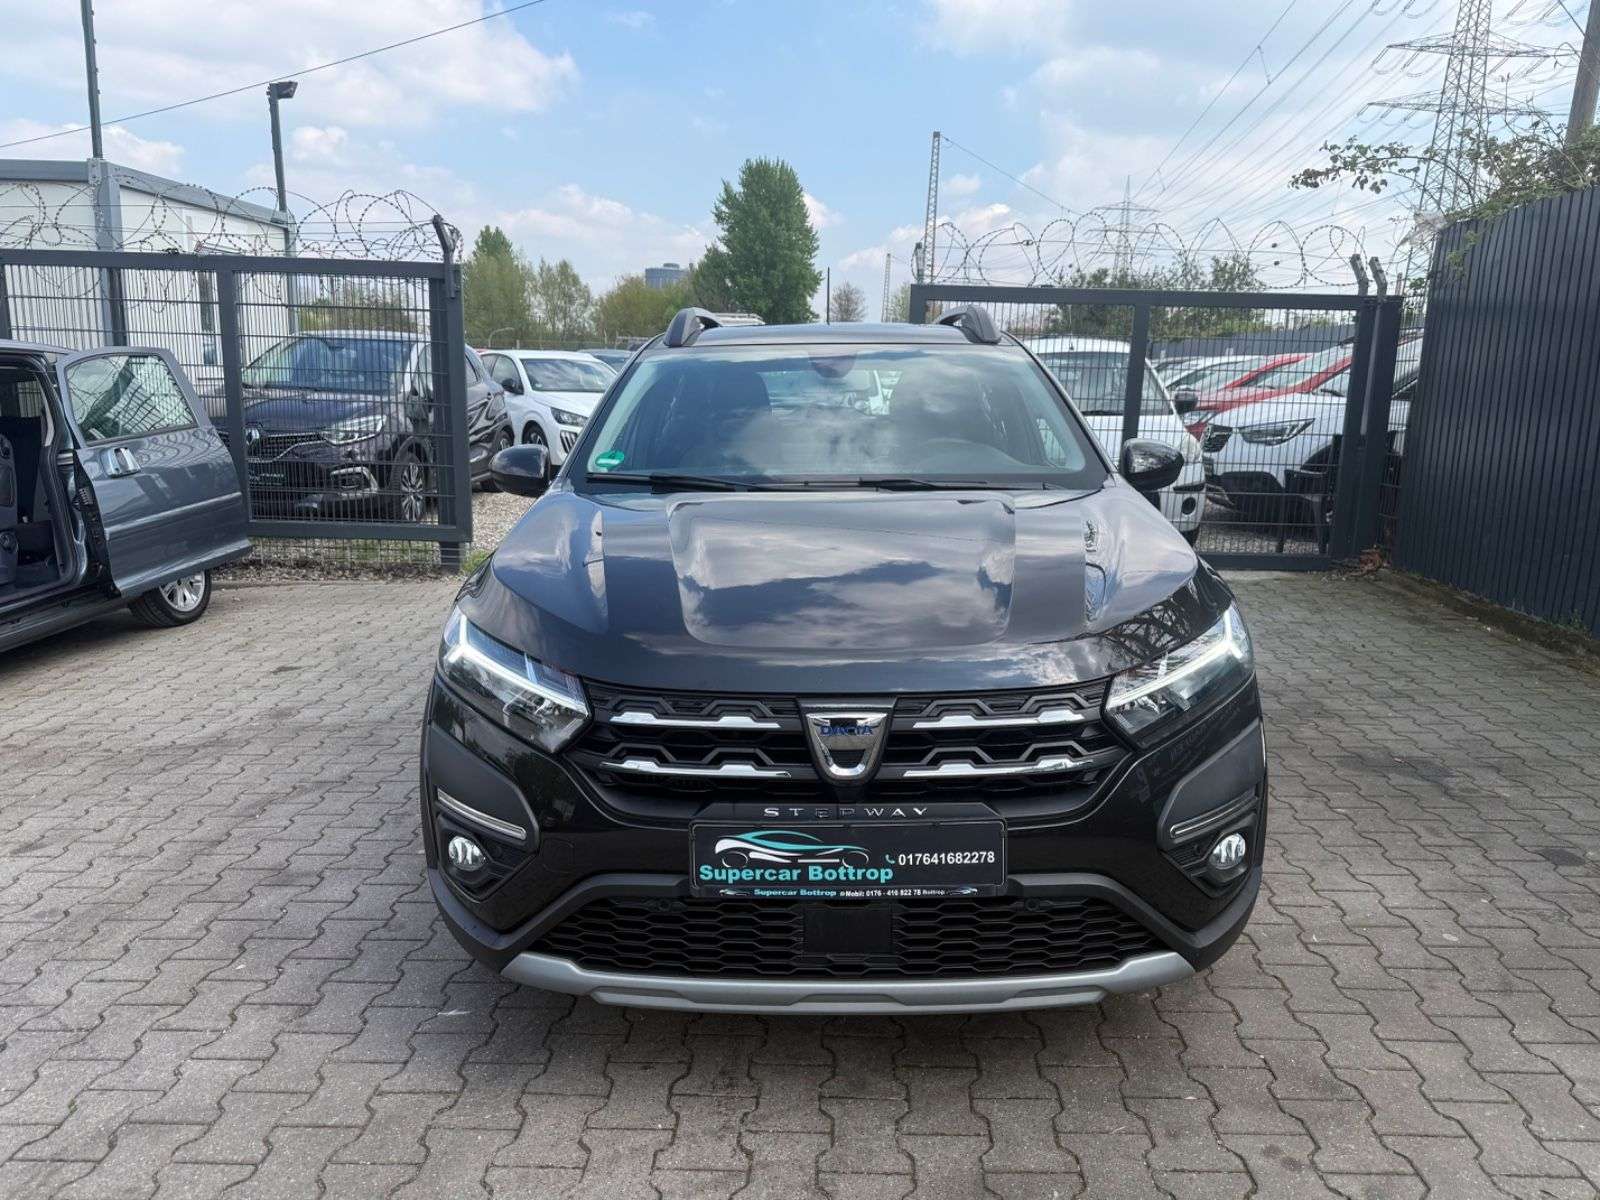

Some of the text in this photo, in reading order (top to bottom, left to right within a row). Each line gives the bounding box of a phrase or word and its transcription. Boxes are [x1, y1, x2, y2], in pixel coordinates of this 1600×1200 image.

[821, 725, 873, 736] DACIA
[763, 807, 928, 818] STEPWAY
[898, 851, 995, 866] 017641682278
[699, 864, 894, 884] Supercar Bottrop
[754, 888, 797, 897] Supercar
[800, 888, 837, 897] Bottrop
[900, 888, 912, 896] 822
[913, 888, 922, 896] 78
